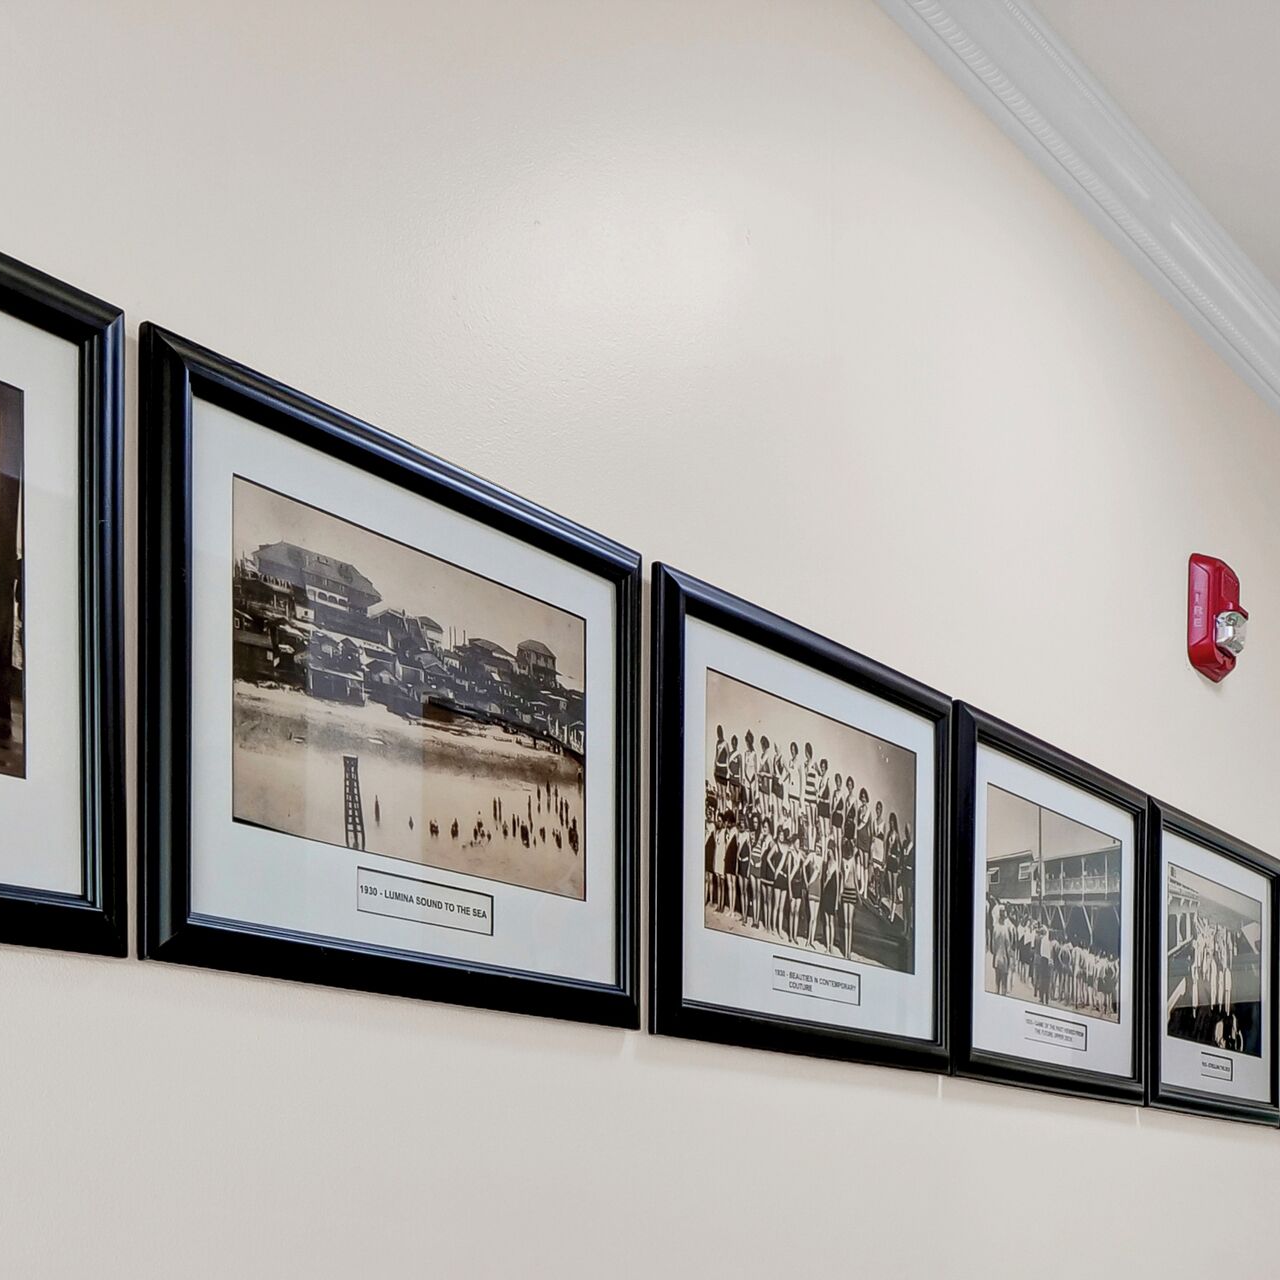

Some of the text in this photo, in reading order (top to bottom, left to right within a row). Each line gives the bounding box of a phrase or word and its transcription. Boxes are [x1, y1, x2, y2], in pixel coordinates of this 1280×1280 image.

[360, 885, 378, 897] 1930
[384, 889, 414, 904] LUMINA
[416, 896, 443, 910] SOUND
[444, 902, 455, 913] TO
[456, 904, 470, 916] THE
[472, 908, 487, 919] SEA
[789, 972, 813, 983] BEAUTIES
[789, 981, 812, 992] COUTURE
